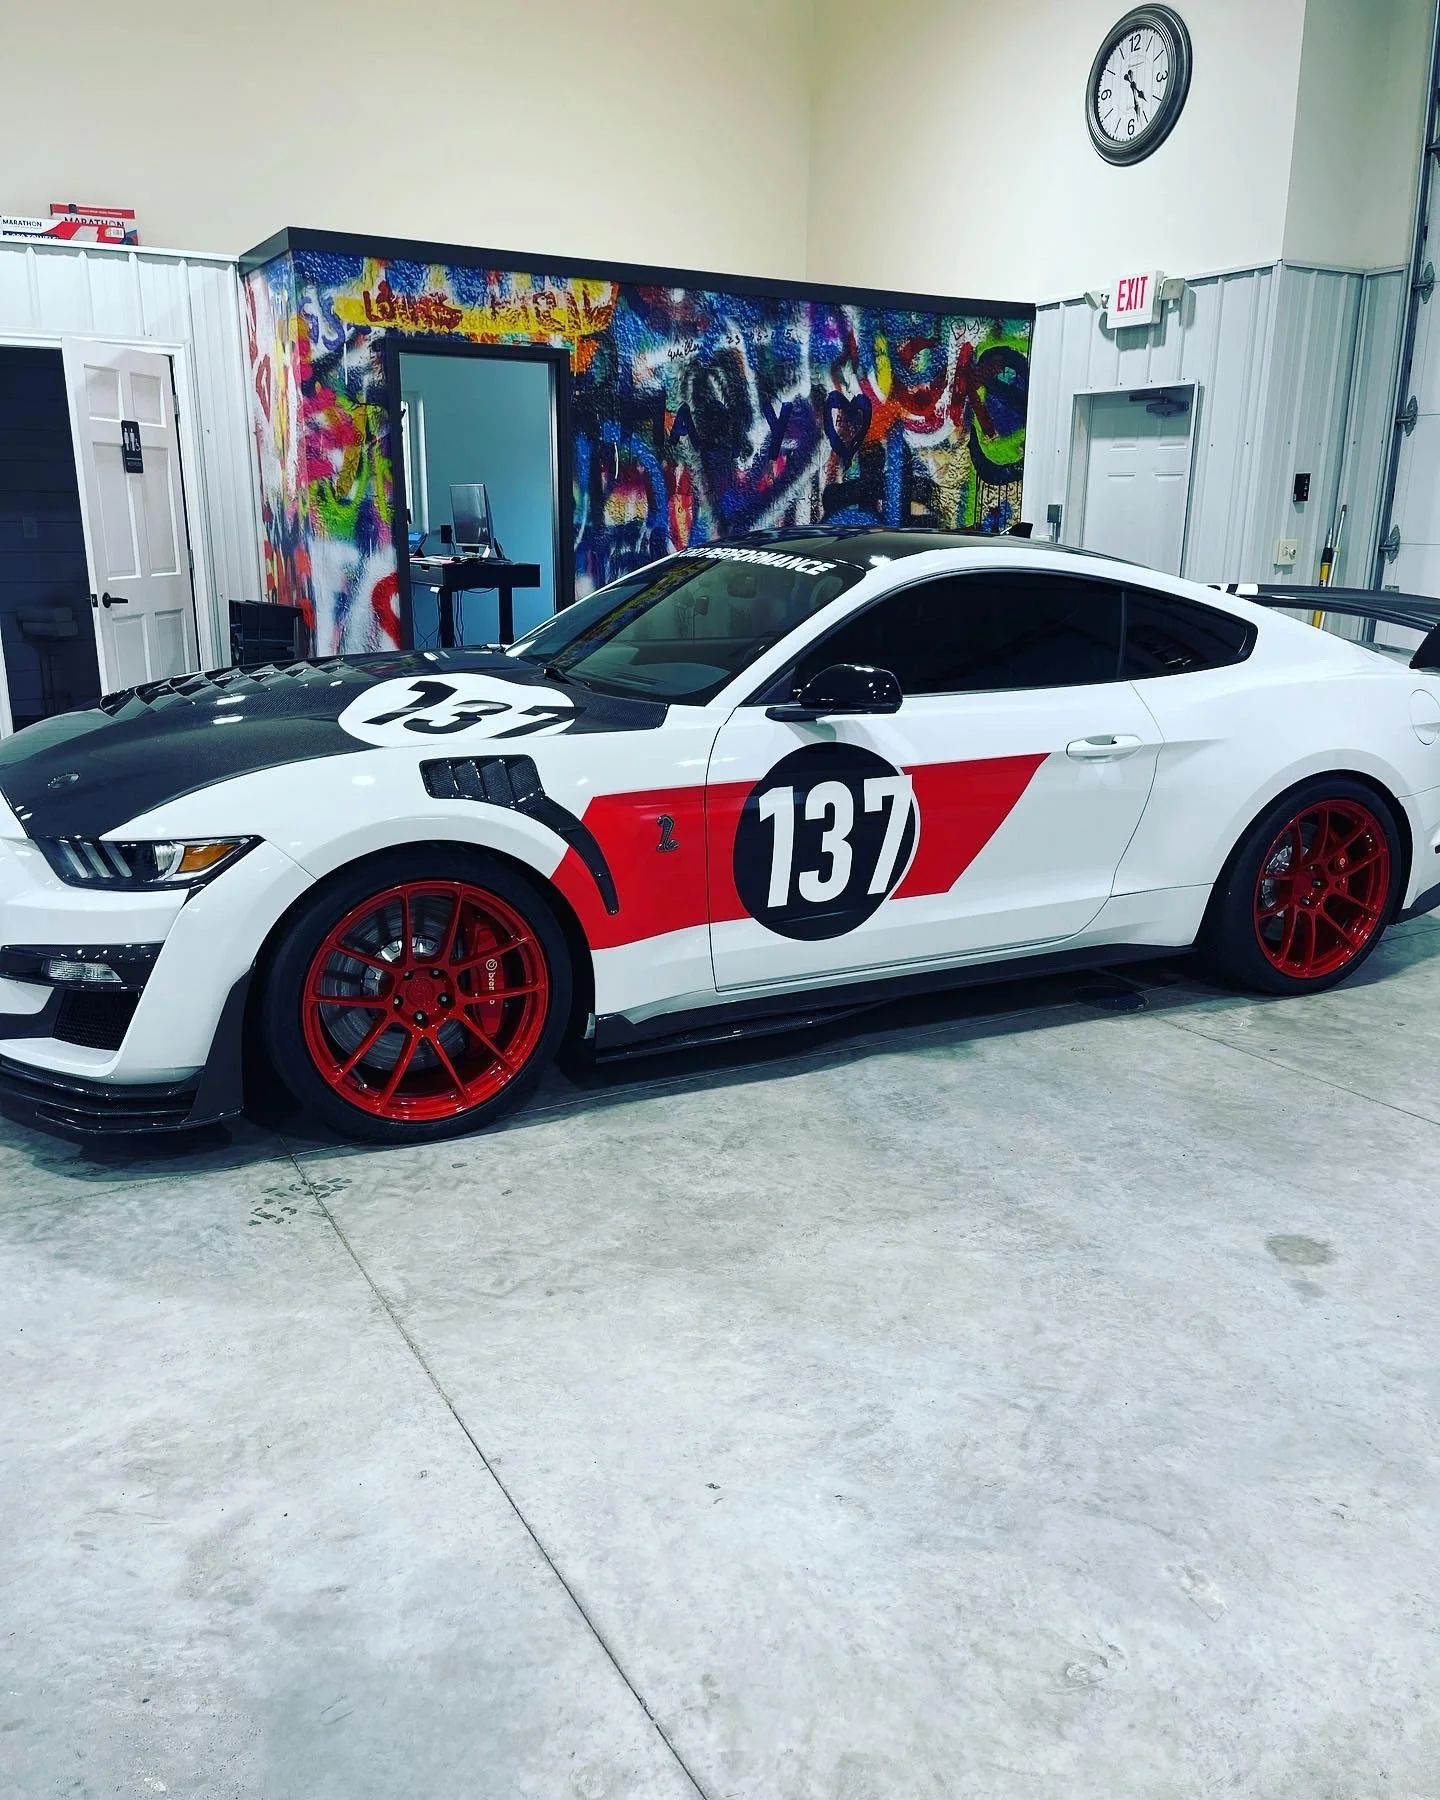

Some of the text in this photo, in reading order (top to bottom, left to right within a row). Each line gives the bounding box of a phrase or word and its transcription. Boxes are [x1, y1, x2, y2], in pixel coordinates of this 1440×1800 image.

[1129, 33, 1141, 53] 12
[1156, 71, 1168, 83] 3
[1100, 89, 1112, 101] 9
[1127, 118, 1135, 136] 6
[2, 218, 42, 227] MARATHON
[1116, 276, 1149, 313] EXIT
[697, 547, 837, 576] PERFORMANCE
[361, 680, 587, 739] 137
[758, 774, 913, 908] 137
